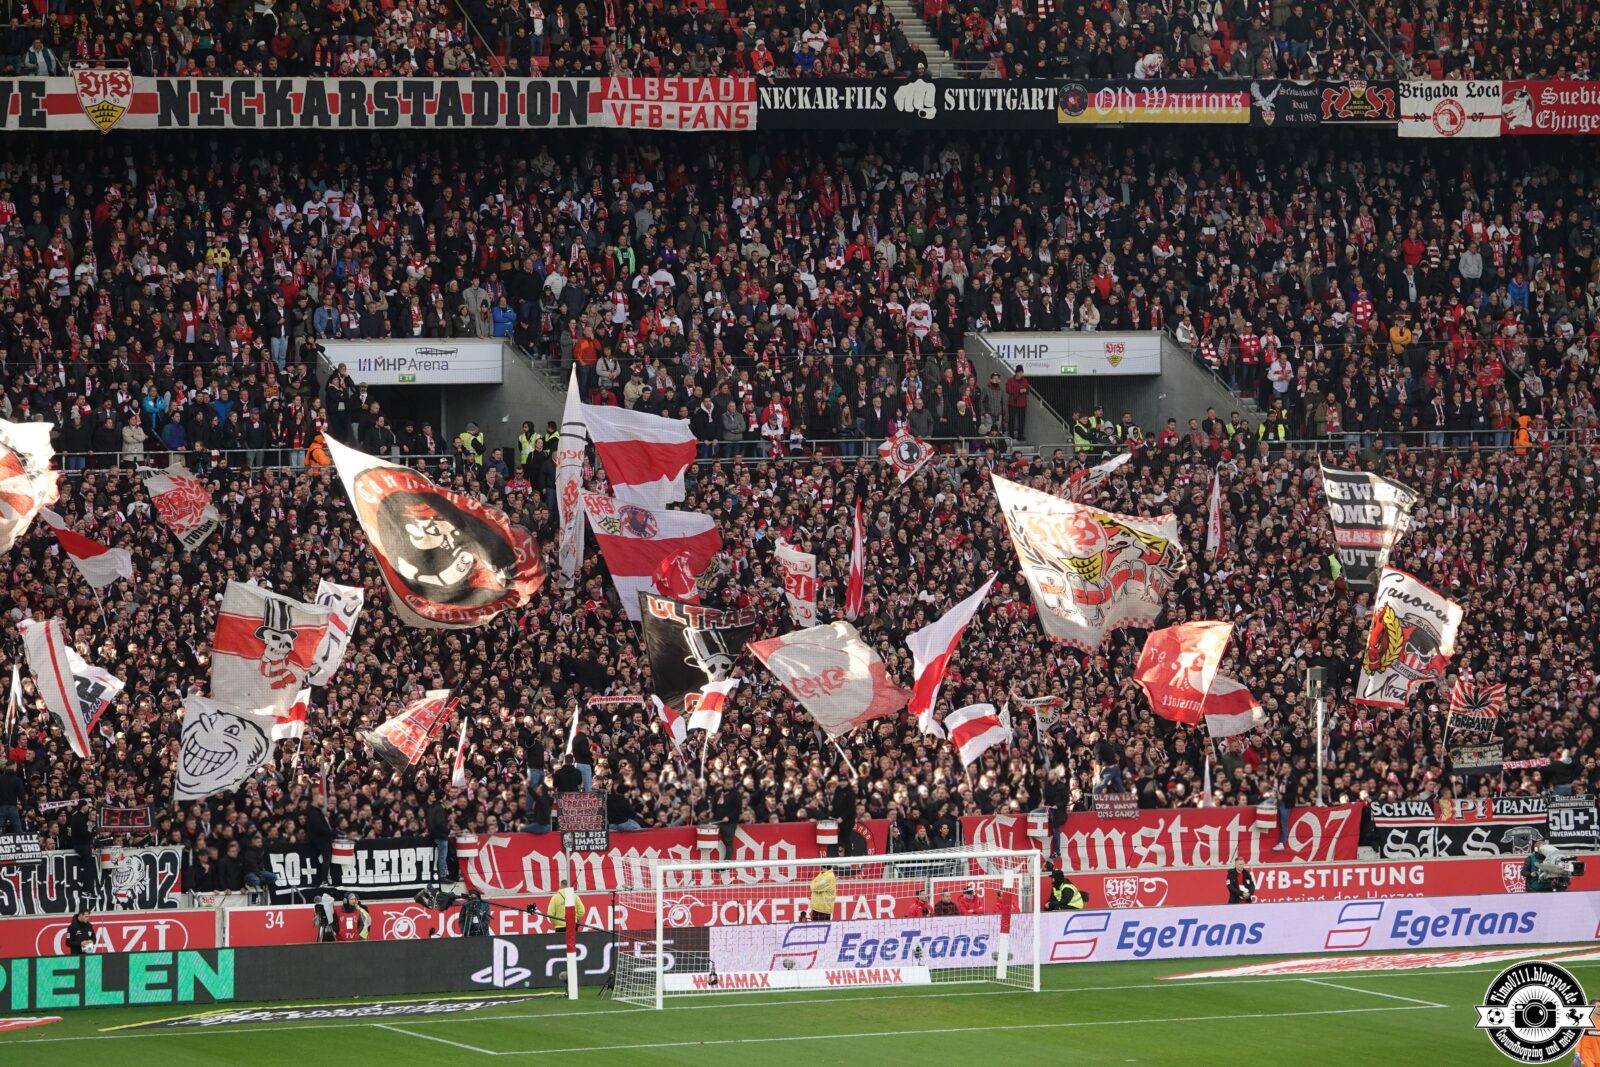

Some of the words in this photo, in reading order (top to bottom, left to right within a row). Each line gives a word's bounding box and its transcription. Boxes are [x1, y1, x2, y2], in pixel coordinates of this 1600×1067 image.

[607, 77, 755, 101] ALBSTADT
[758, 86, 887, 110] NECKAR-FILS
[944, 87, 1058, 111] STUTTGART
[1094, 85, 1131, 115] Old
[1141, 85, 1243, 115] Warriors
[1400, 82, 1458, 101] Brigada
[1466, 82, 1500, 99] Loca
[157, 80, 590, 127] NECKARSTADION
[611, 103, 750, 129] VFB-FANS
[1013, 344, 1049, 359] MHP
[647, 595, 756, 630] ULTRAS
[1548, 807, 1599, 831] 50+1
[16, 834, 39, 844] ALLE
[21, 843, 41, 852] UND
[1287, 808, 1352, 863] 97
[1105, 878, 1136, 897] VfB
[1250, 865, 1425, 890] VfB-STIFTUNG
[265, 911, 285, 929] 34
[703, 894, 897, 927] JOKERTAR
[1116, 918, 1266, 957] EgeTrans
[1390, 907, 1537, 945] EgeTrans
[545, 940, 675, 977] PS5
[837, 930, 990, 968] EgeTrans
[0, 948, 235, 1010] IELEN
[692, 972, 770, 989] WNAMAX
[825, 967, 903, 986] WINAMAX
